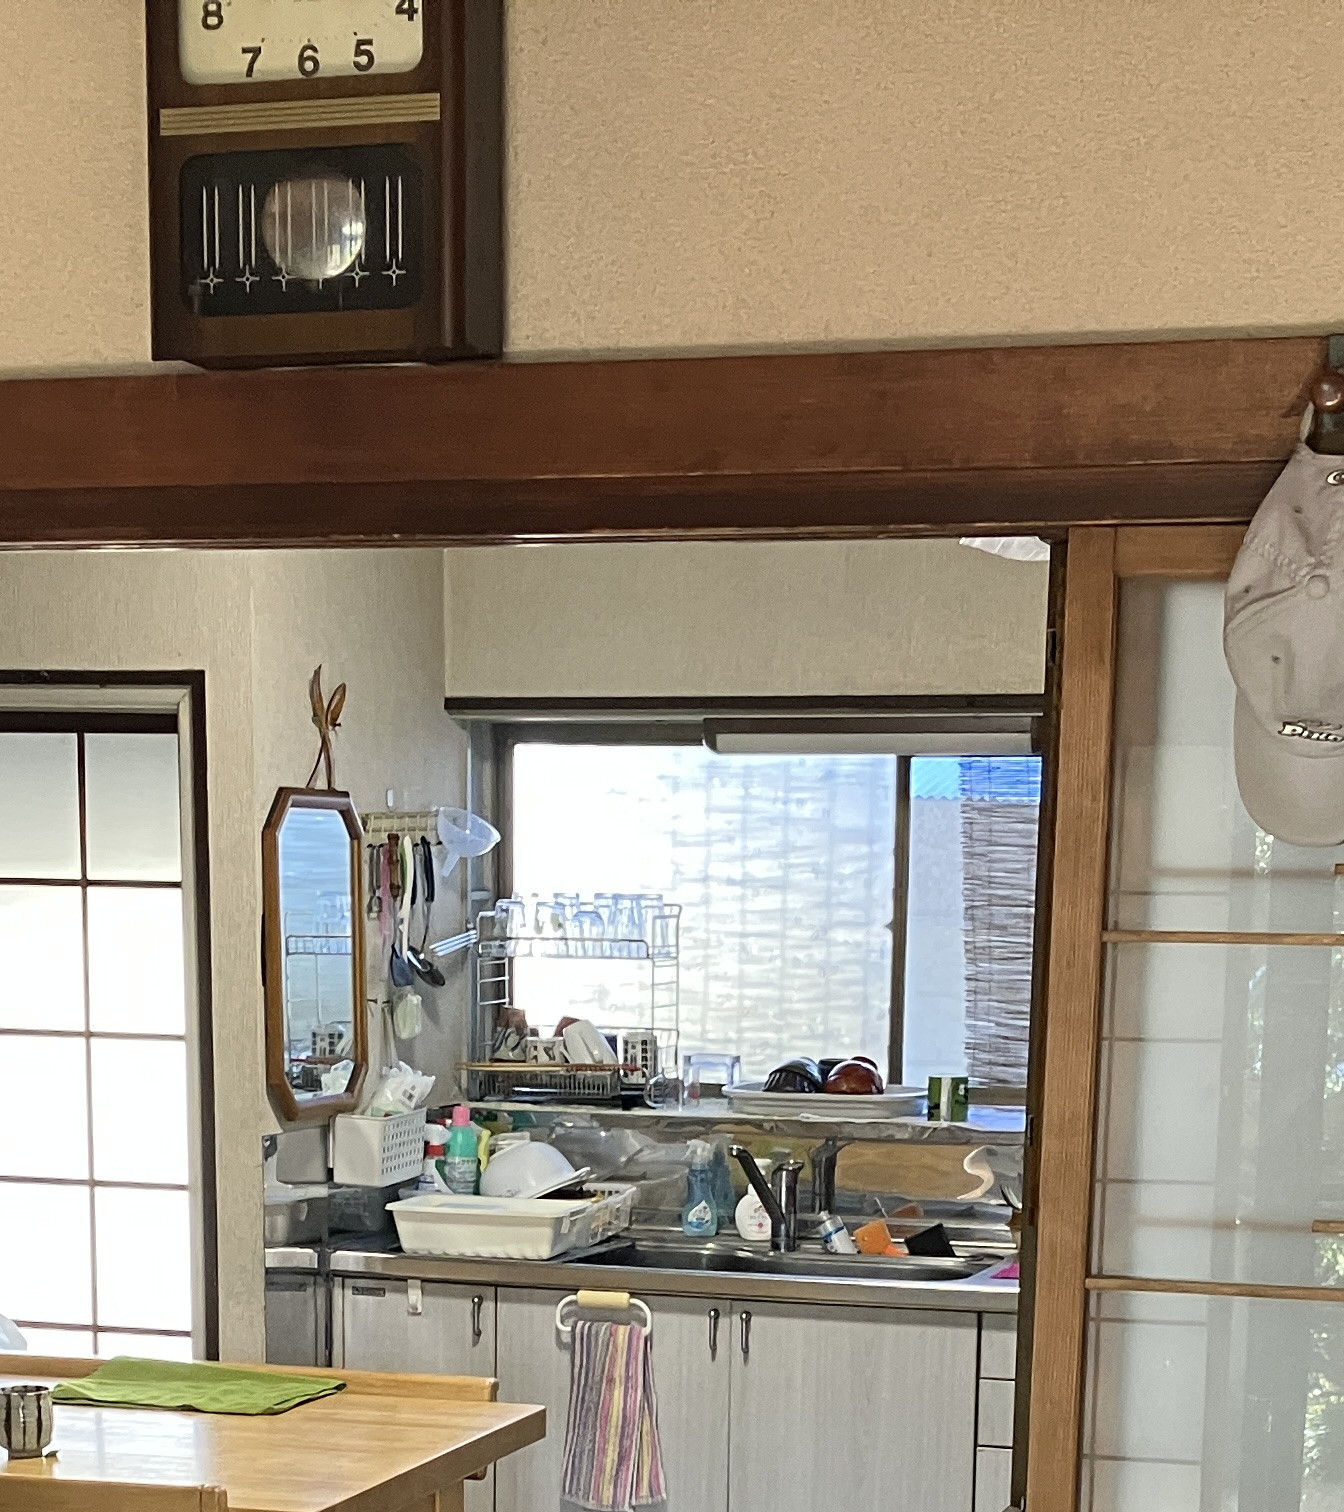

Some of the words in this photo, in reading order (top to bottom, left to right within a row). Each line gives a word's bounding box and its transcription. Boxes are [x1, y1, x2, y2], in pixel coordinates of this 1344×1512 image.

[201, 0, 224, 31] 8
[395, 0, 419, 22] 4
[241, 45, 262, 78] 7
[297, 43, 321, 78] 6
[352, 38, 375, 72] 5
